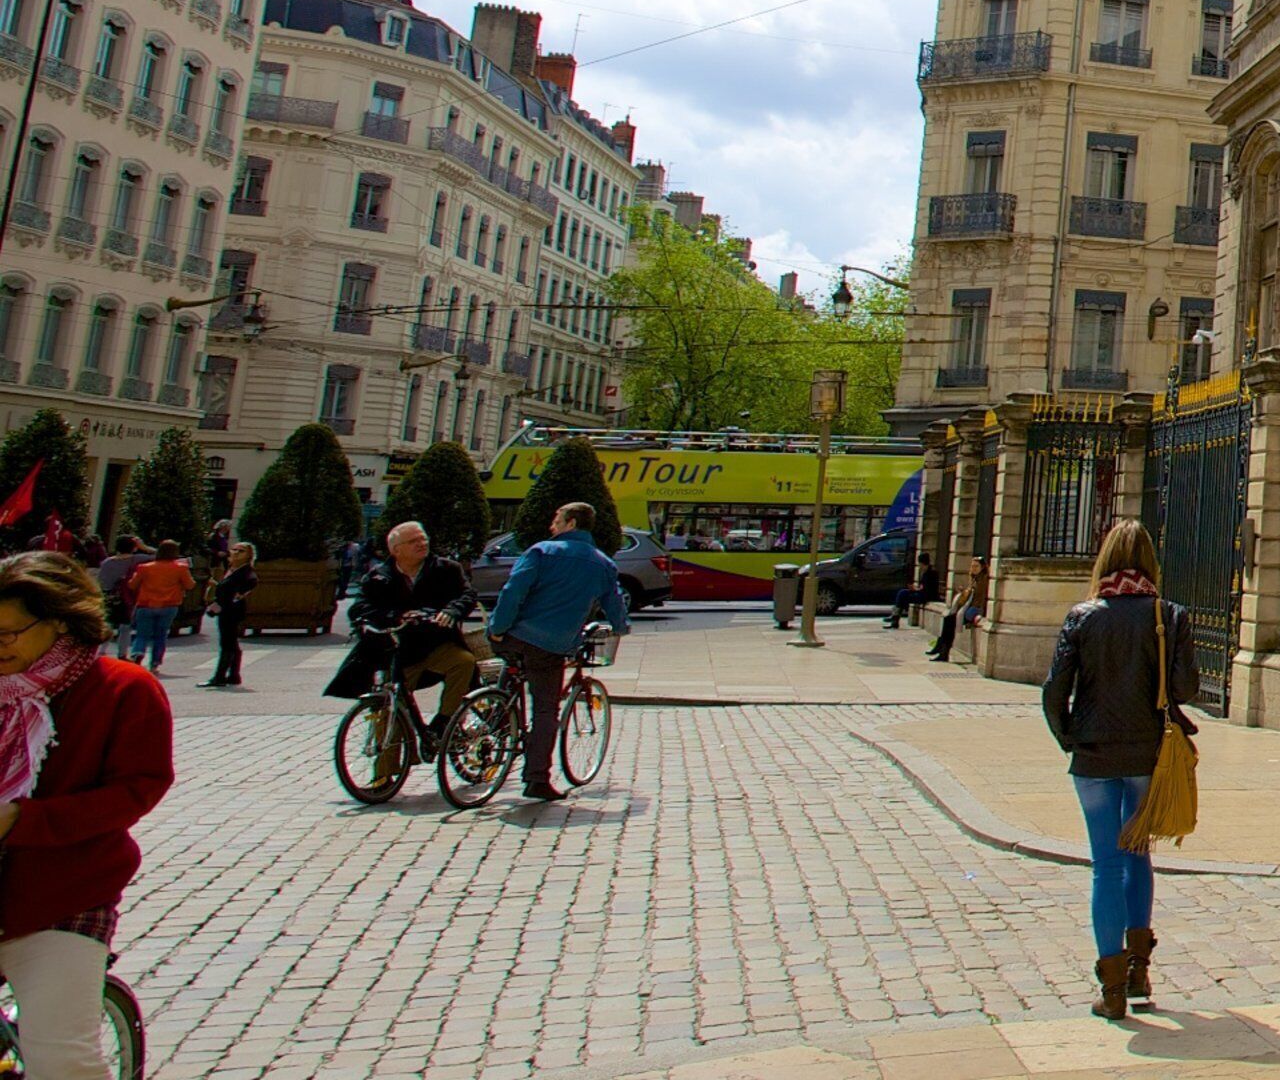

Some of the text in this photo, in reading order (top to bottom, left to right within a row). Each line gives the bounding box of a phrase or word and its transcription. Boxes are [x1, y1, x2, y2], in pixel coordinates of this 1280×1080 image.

[127, 427, 145, 438] BANK
[646, 487, 657, 496] by
[776, 481, 792, 492] 11
